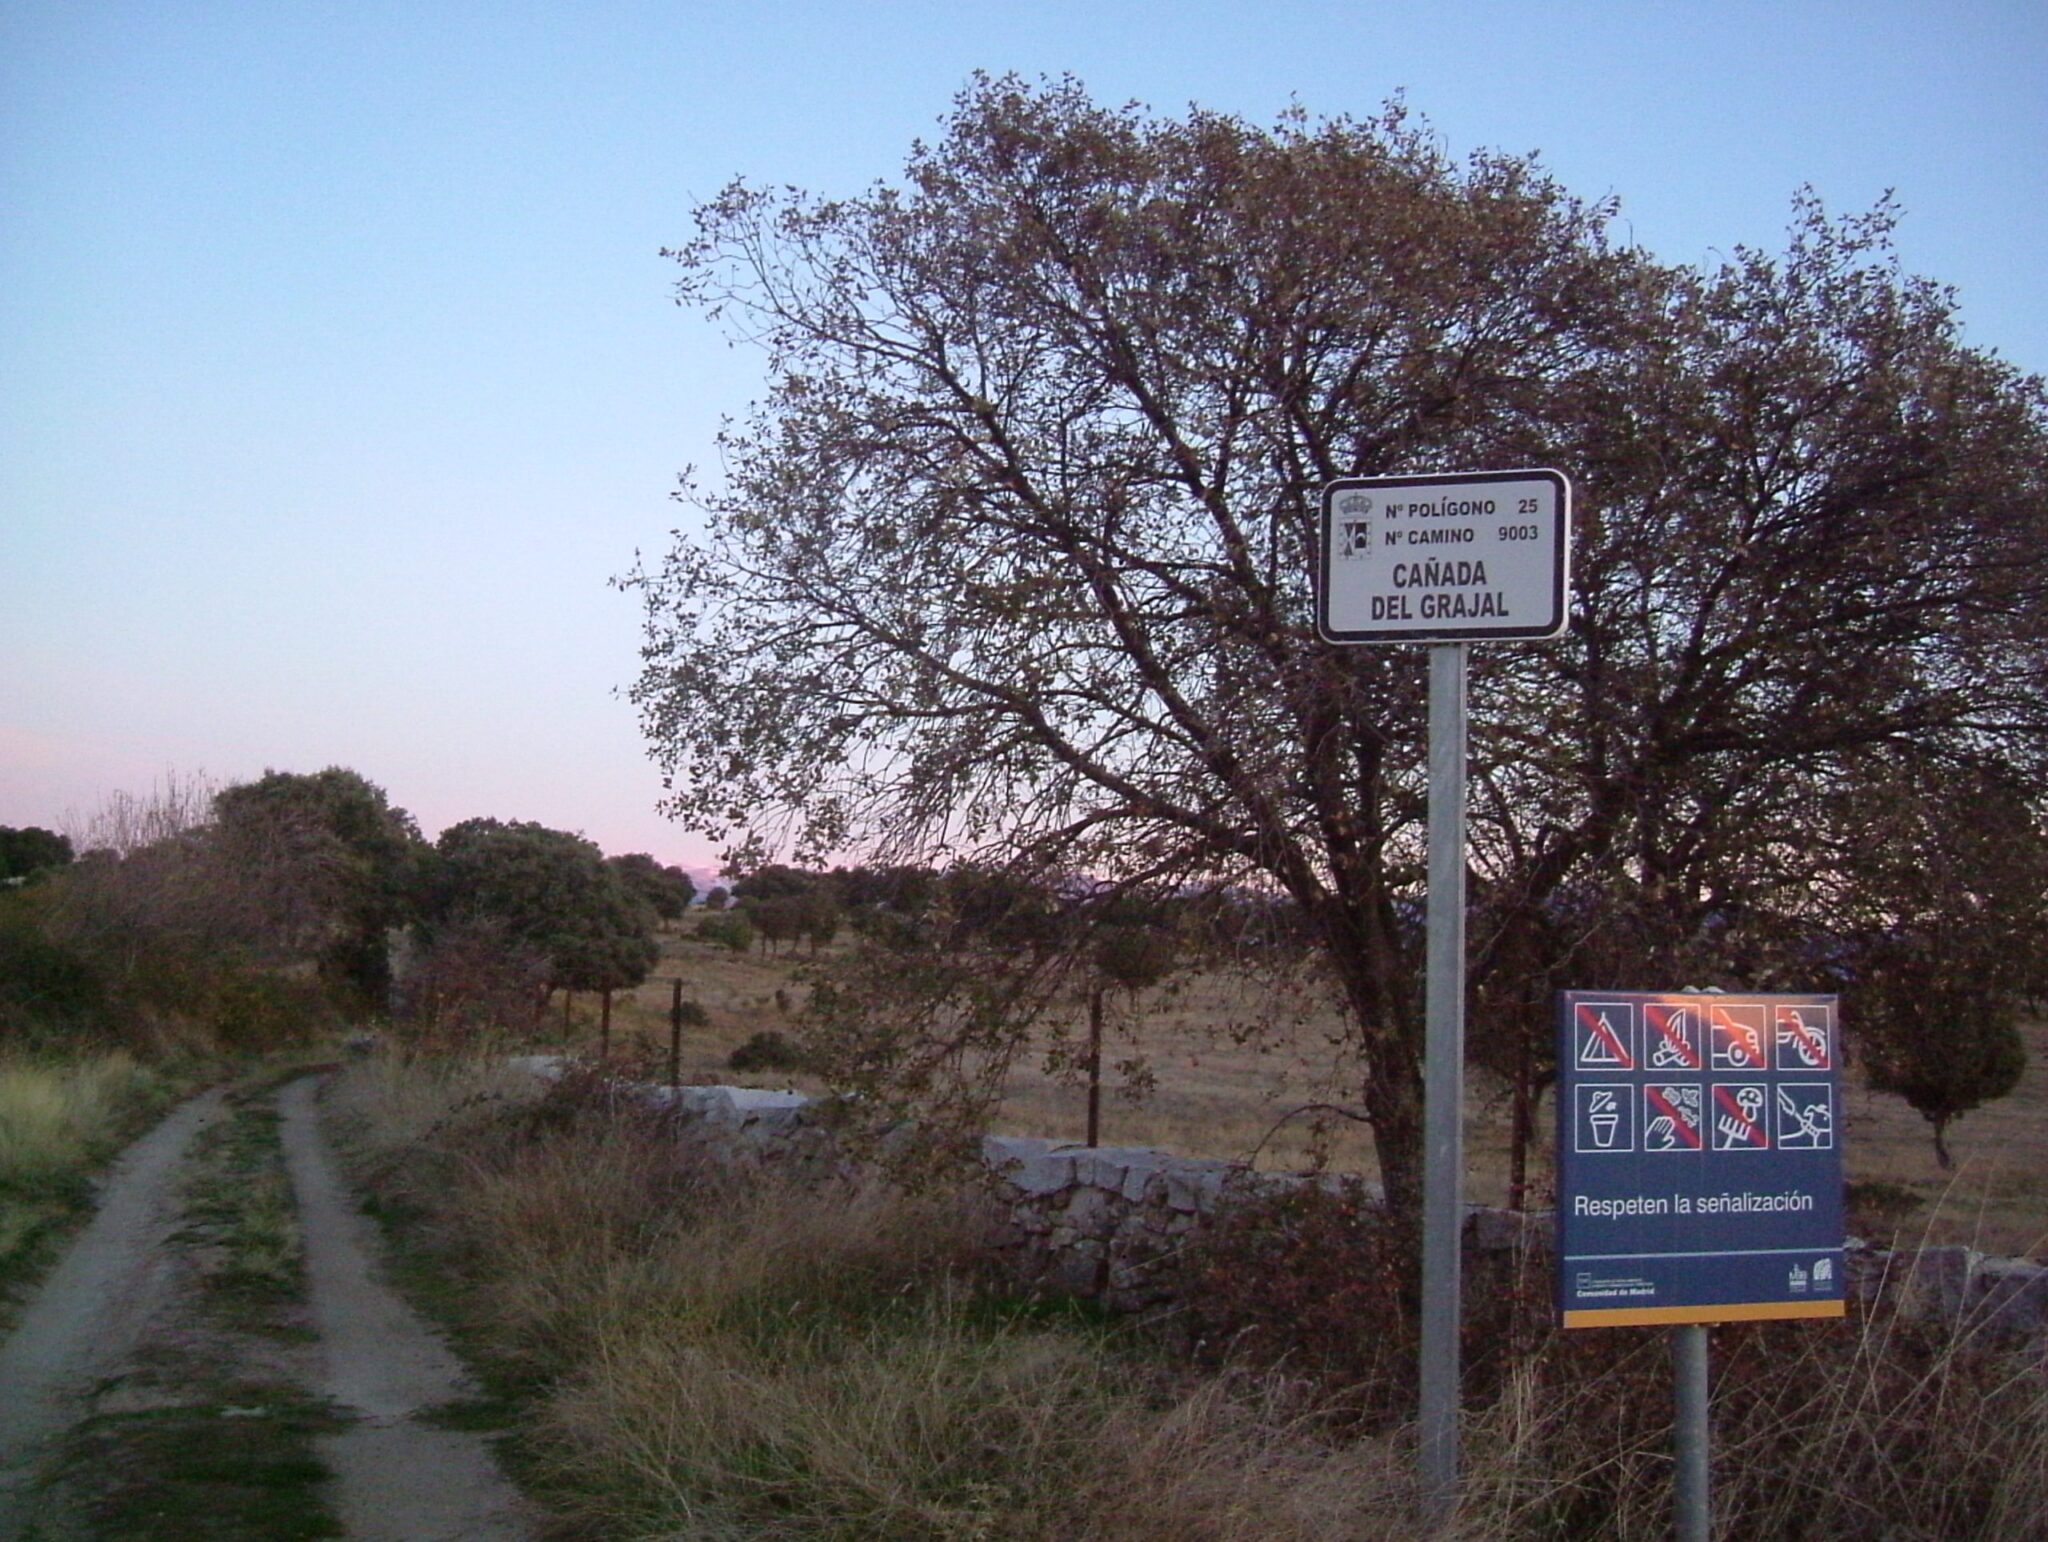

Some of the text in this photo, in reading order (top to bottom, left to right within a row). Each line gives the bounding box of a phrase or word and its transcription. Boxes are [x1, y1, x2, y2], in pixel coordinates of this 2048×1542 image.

[1408, 497, 1495, 518] POLÍGONO
[1518, 499, 1538, 514] 25
[1408, 528, 1474, 545] CAMINO
[1498, 525, 1538, 541] 9003
[1393, 557, 1487, 588] CAÑADA
[1371, 592, 1509, 621] DEL GRAJAL
[1574, 1190, 1813, 1220] Respeten la señalización
